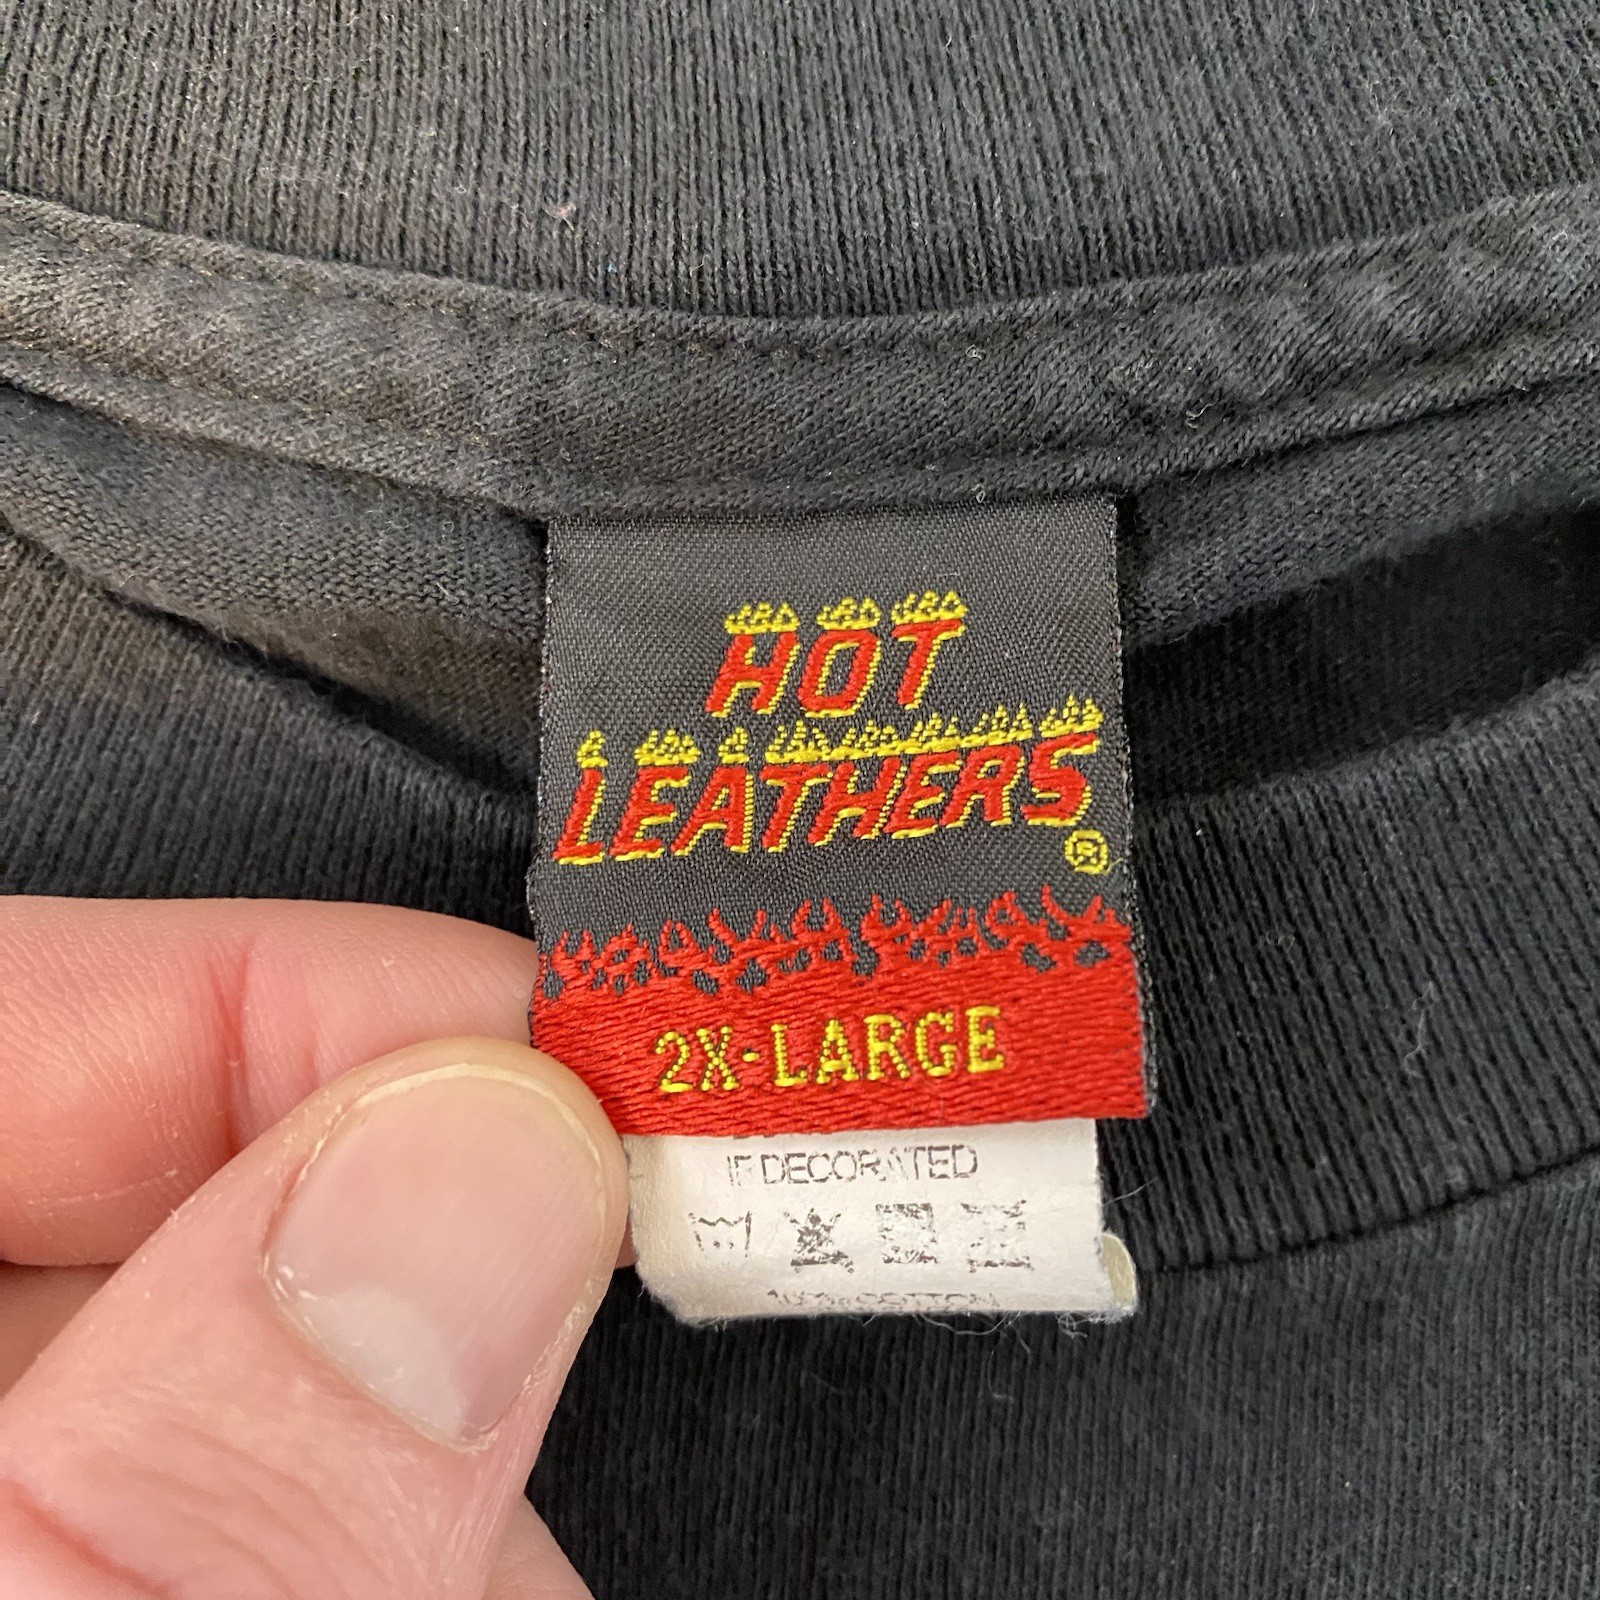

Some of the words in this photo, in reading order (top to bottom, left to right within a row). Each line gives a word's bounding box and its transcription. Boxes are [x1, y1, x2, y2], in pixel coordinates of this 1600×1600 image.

[704, 619, 967, 718] HOT
[552, 731, 1098, 866] LEATHERS
[655, 1005, 1005, 1093] 2X-LARGE
[726, 1154, 752, 1186] IF
[760, 1144, 979, 1184] DECORATED
